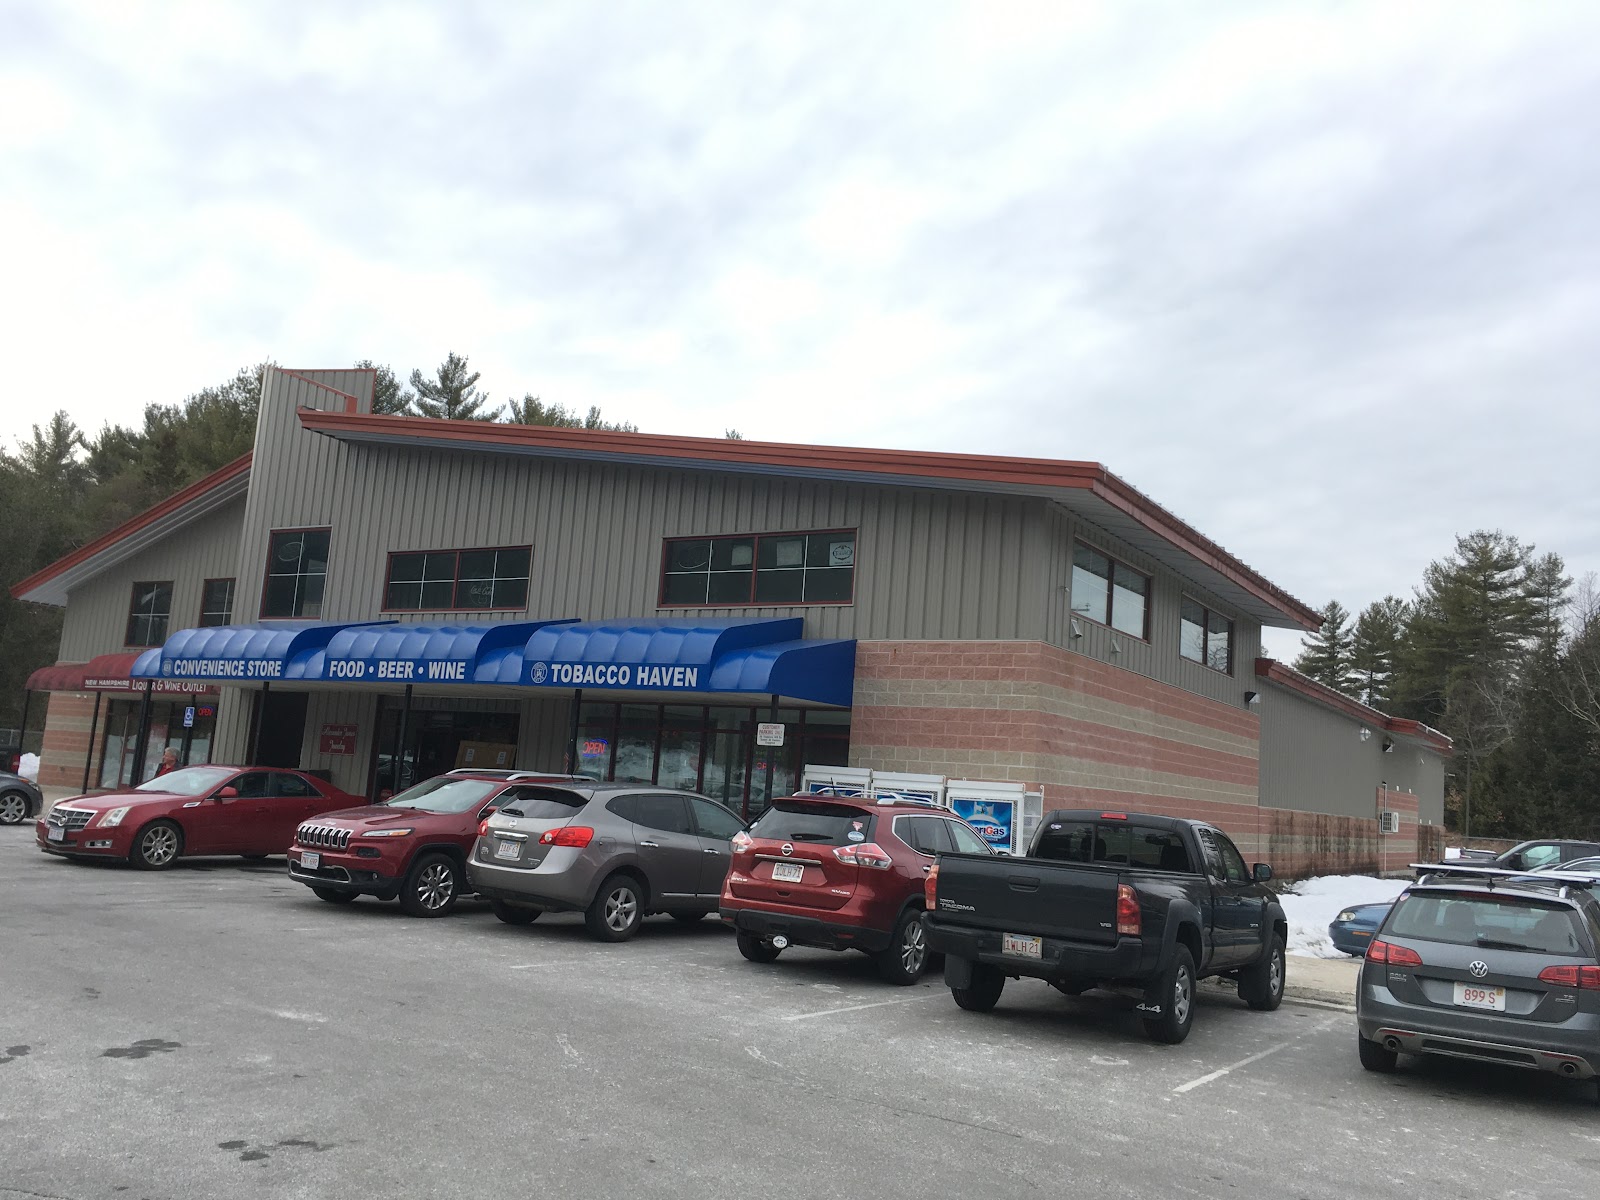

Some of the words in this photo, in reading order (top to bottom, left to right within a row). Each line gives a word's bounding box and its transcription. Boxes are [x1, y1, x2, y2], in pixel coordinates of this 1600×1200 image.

[174, 659, 244, 676] CONVENIENCE
[247, 660, 282, 677] STORE
[329, 660, 365, 678] FOOD
[378, 661, 414, 679] BEER
[428, 661, 466, 680] WINE
[551, 663, 631, 685] TOBACCO
[636, 666, 698, 687] HAVEN
[132, 680, 155, 691] LIQUR
[157, 680, 163, 691] &
[198, 707, 213, 717] OPEN
[582, 741, 606, 755] OPEN
[974, 826, 1005, 836] eriGas
[939, 902, 976, 912] TACOMA
[1464, 988, 1486, 1003] 899
[1488, 991, 1496, 1004] S
[1135, 1002, 1162, 1014] 4x4
